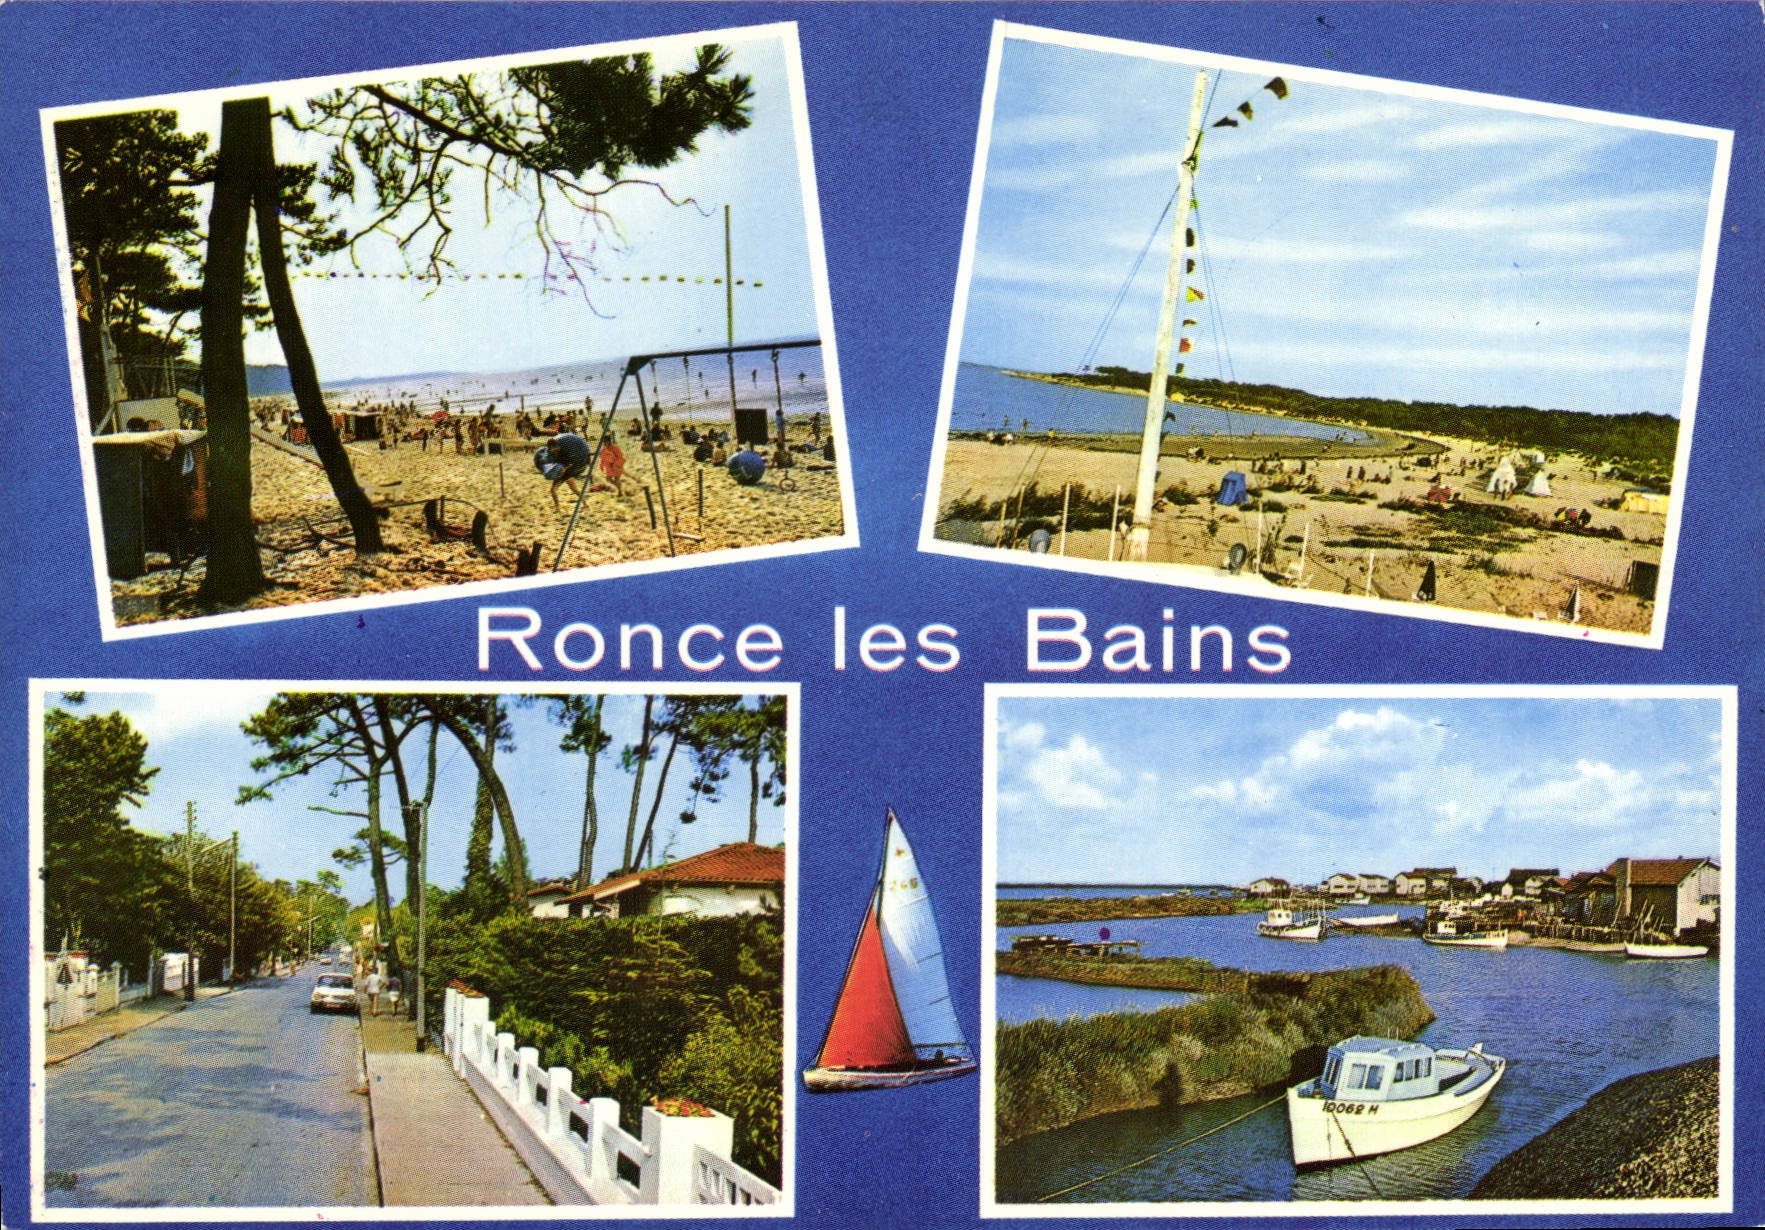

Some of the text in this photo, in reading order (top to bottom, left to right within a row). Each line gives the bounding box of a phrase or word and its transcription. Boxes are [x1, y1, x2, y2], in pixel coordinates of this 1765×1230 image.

[477, 606, 1292, 673] Ronce les Bains
